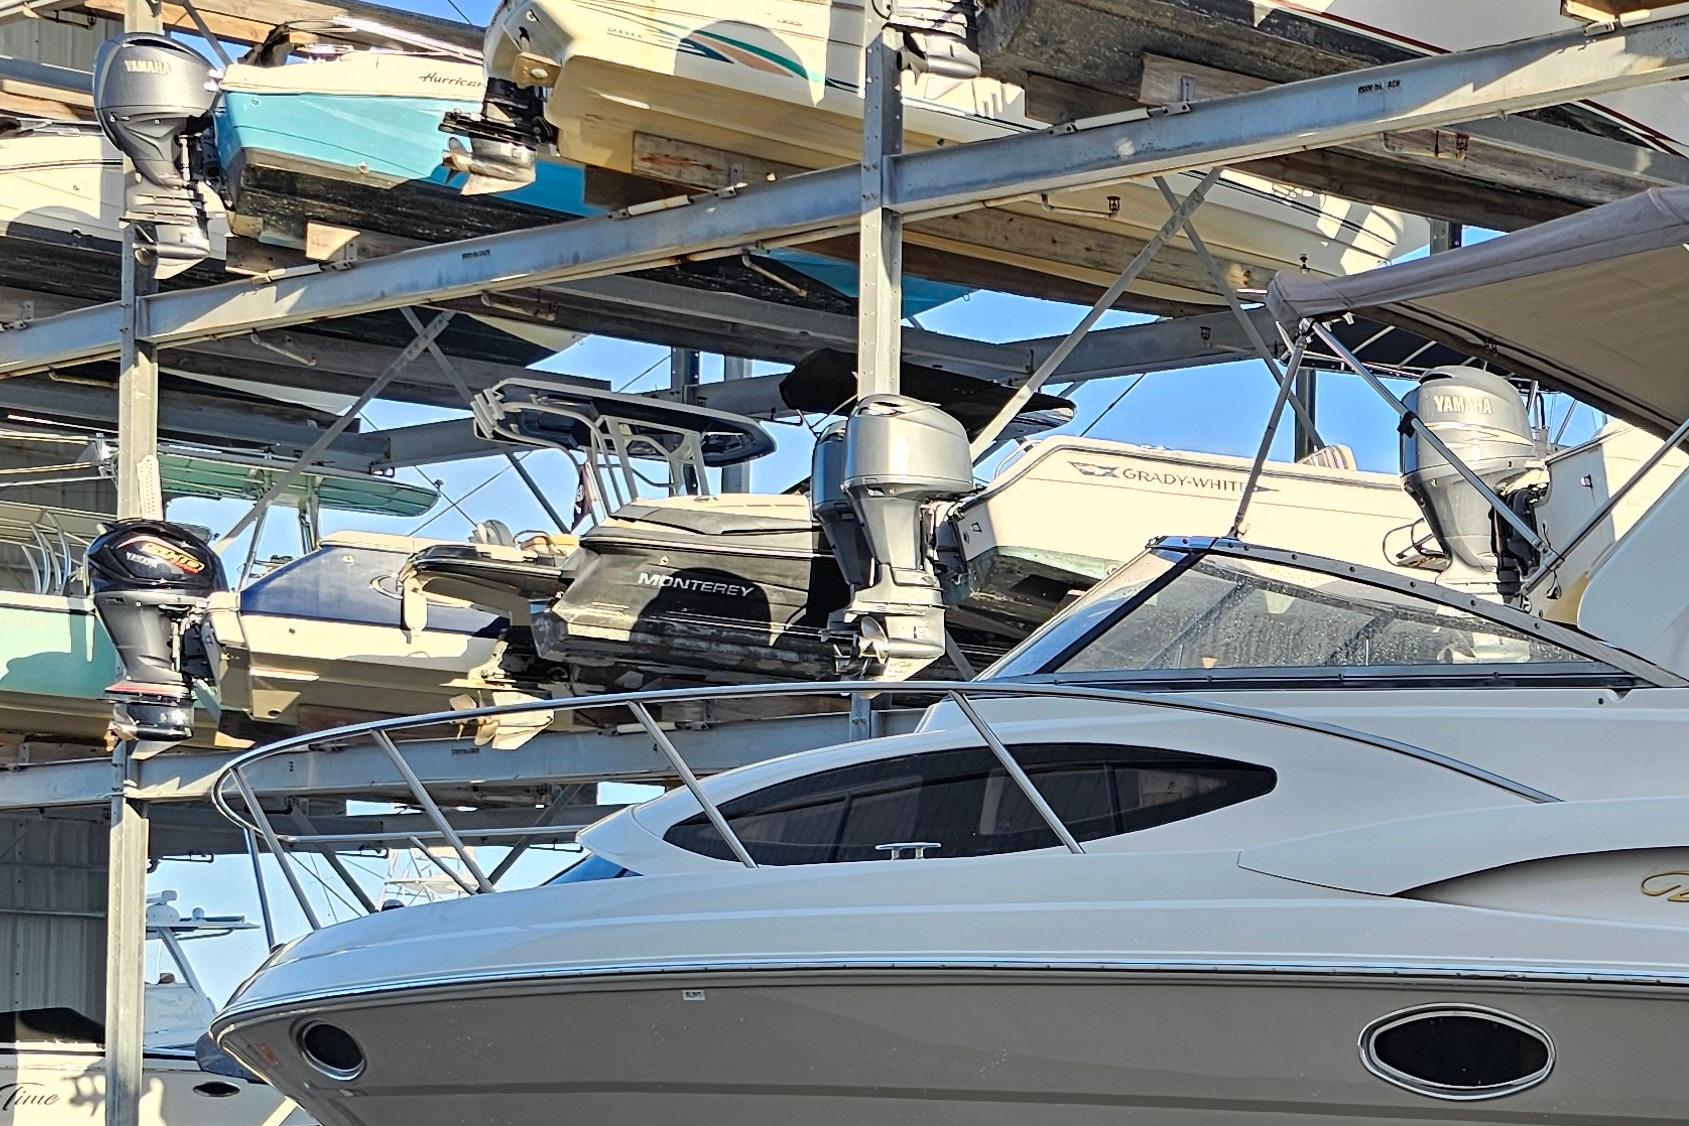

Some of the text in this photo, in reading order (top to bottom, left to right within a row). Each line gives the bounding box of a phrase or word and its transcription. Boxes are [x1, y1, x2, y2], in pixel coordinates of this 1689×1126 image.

[124, 60, 171, 74] YAMAHA
[1433, 395, 1491, 415] YAMAHA
[637, 572, 755, 598] MONTEREY
[0, 1082, 60, 1111] Time
